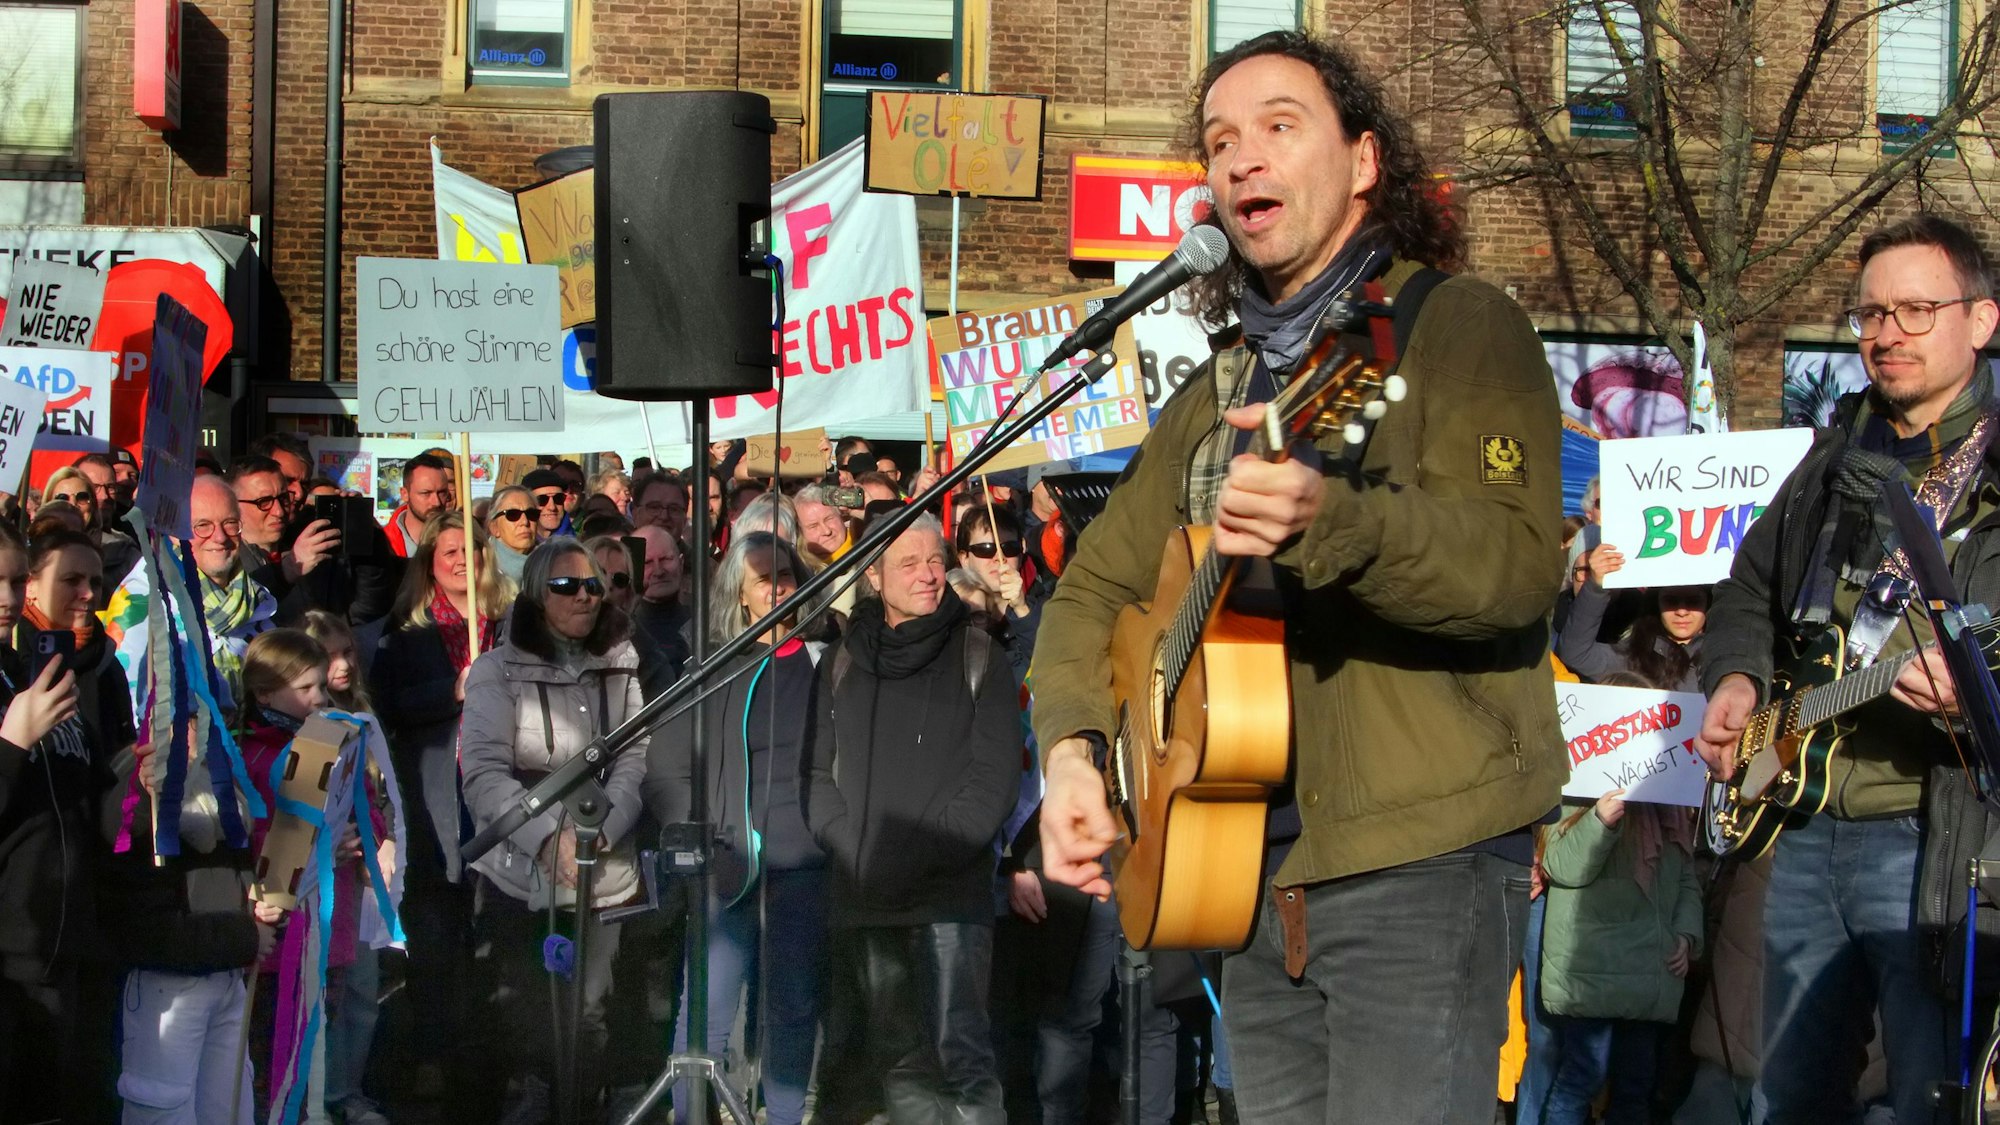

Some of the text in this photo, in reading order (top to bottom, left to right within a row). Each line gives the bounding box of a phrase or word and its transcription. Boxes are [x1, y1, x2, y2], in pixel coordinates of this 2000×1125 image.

[480, 49, 525, 62] Allianz
[833, 63, 877, 76] Allianz
[881, 94, 1024, 146] Vielfalt
[20, 284, 62, 311] NIE
[378, 276, 534, 310] Du hast eine
[20, 312, 91, 345] WIEDER
[955, 303, 1079, 349] Braun
[376, 331, 455, 363] schöne
[465, 329, 552, 363] Stimme
[14, 364, 76, 394] AfD
[374, 385, 556, 424] GEH WÄHLEN
[202, 428, 217, 447] 11
[1626, 455, 1770, 492] WIR SIND
[1566, 701, 1681, 771] IDERSTAND
